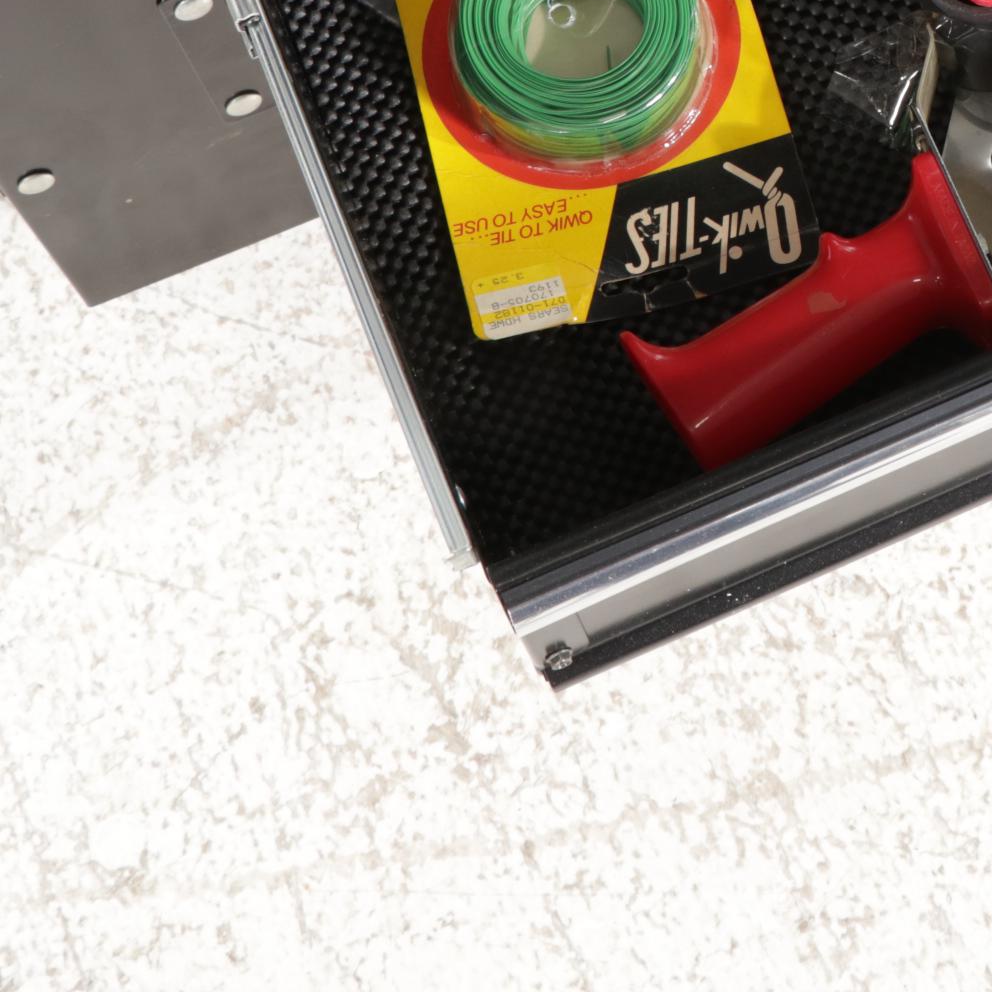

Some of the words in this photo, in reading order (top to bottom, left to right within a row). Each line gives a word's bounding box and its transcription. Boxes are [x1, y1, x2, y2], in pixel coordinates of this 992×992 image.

[453, 217, 488, 237] USE
[493, 211, 517, 227] TO
[548, 210, 593, 233] QWIK
[519, 224, 543, 240] TO
[528, 304, 569, 321] SEARS
[488, 316, 522, 330] HDWE
